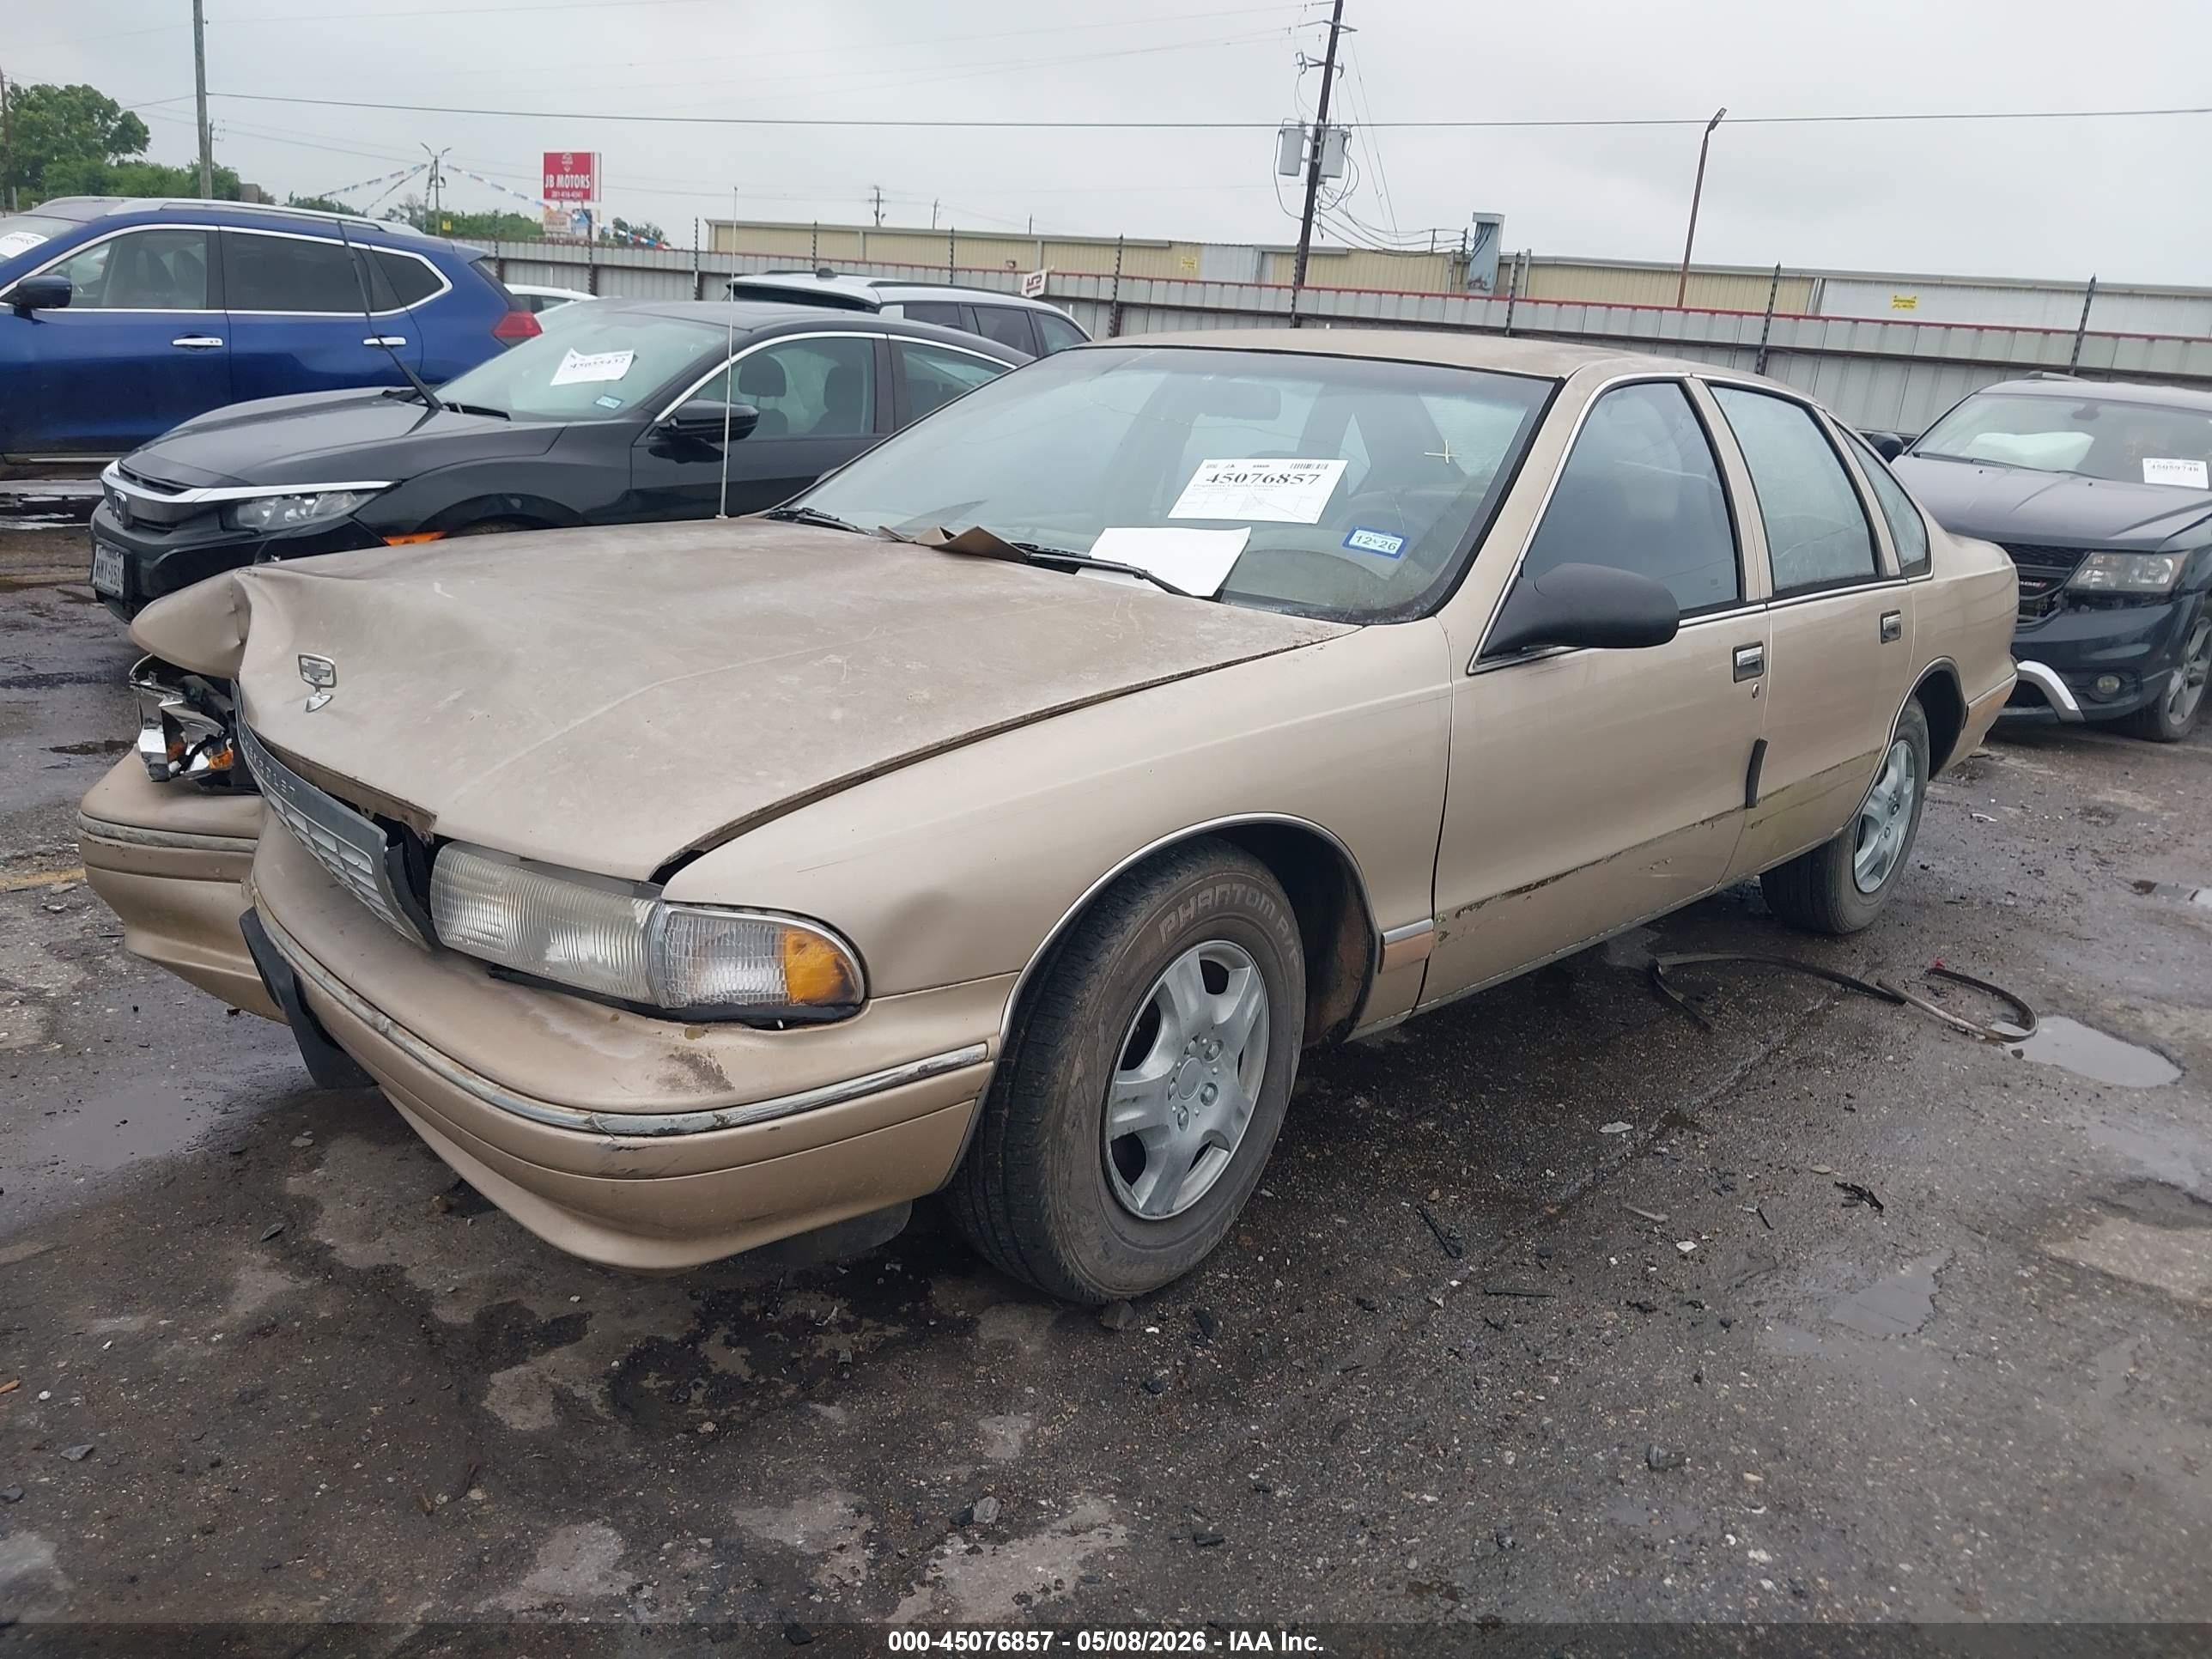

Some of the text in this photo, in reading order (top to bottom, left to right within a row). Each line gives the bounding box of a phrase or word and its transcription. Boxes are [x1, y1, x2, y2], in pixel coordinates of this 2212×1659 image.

[545, 173, 591, 190] JB MOTORS
[1205, 472, 1323, 485] 45076857
[1158, 883, 1277, 945] PHANTOM
